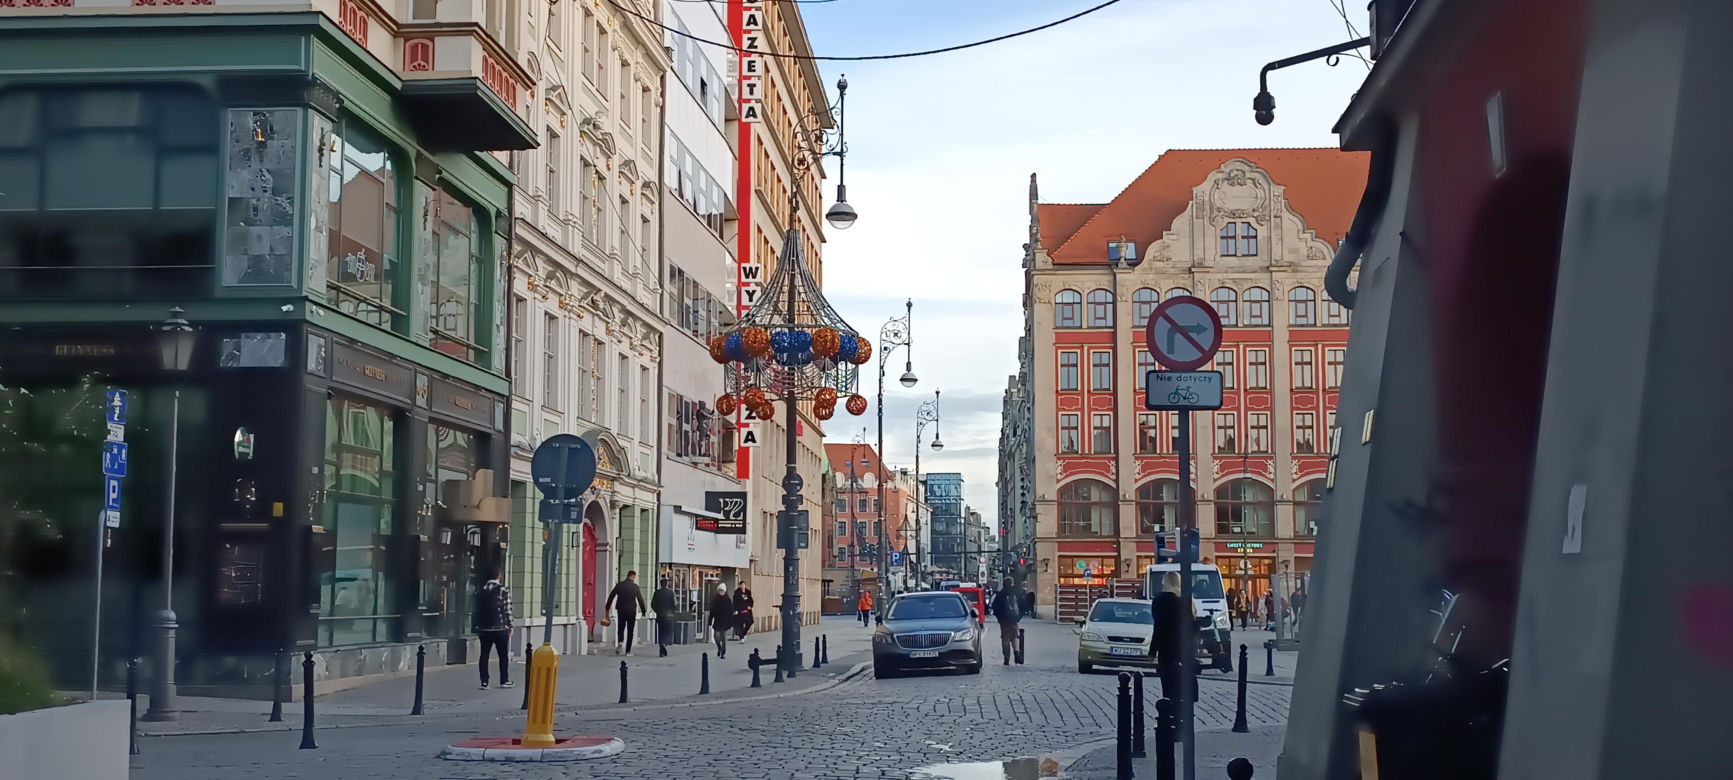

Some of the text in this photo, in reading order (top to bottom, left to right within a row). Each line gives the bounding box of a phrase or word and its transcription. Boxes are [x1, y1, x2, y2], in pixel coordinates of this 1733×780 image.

[745, 0, 759, 119] AZETA
[1156, 373, 1213, 384] Nie dotyczy
[109, 479, 119, 506] P
